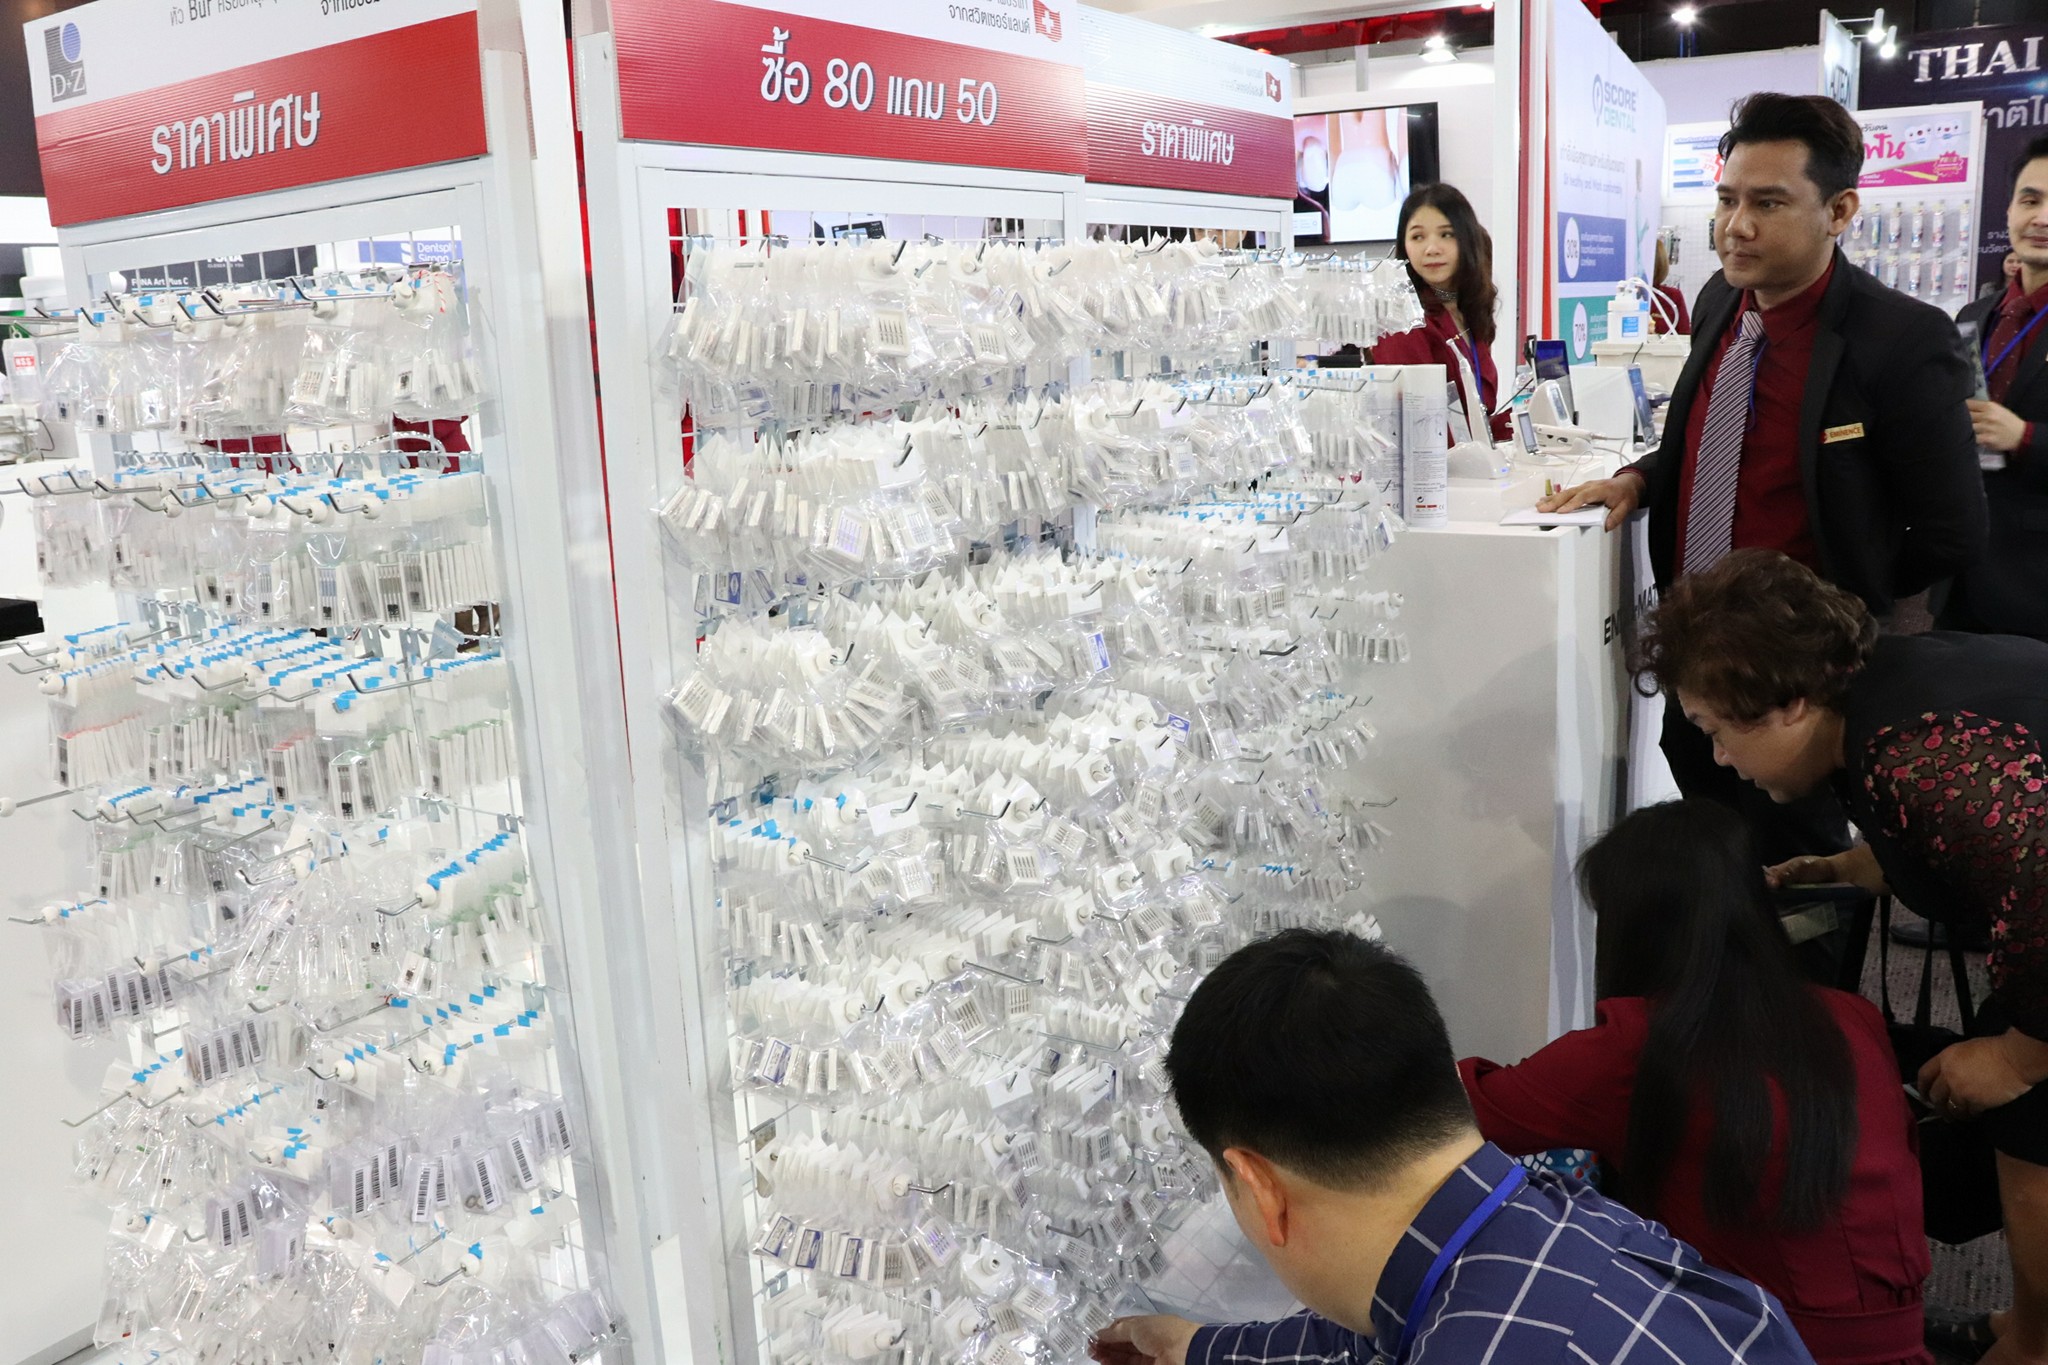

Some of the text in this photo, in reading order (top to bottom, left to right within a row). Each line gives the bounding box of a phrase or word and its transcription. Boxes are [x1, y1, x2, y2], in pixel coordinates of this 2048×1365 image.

[760, 26, 998, 126] ซื้อ 80 แถม 50
[1908, 36, 2044, 82] THAI
[1603, 81, 1637, 112] SCORE
[1603, 106, 1637, 133] DENTAL
[151, 90, 321, 175] ราคาพิเศษ
[1141, 119, 1235, 166] ราคาพิเศษ
